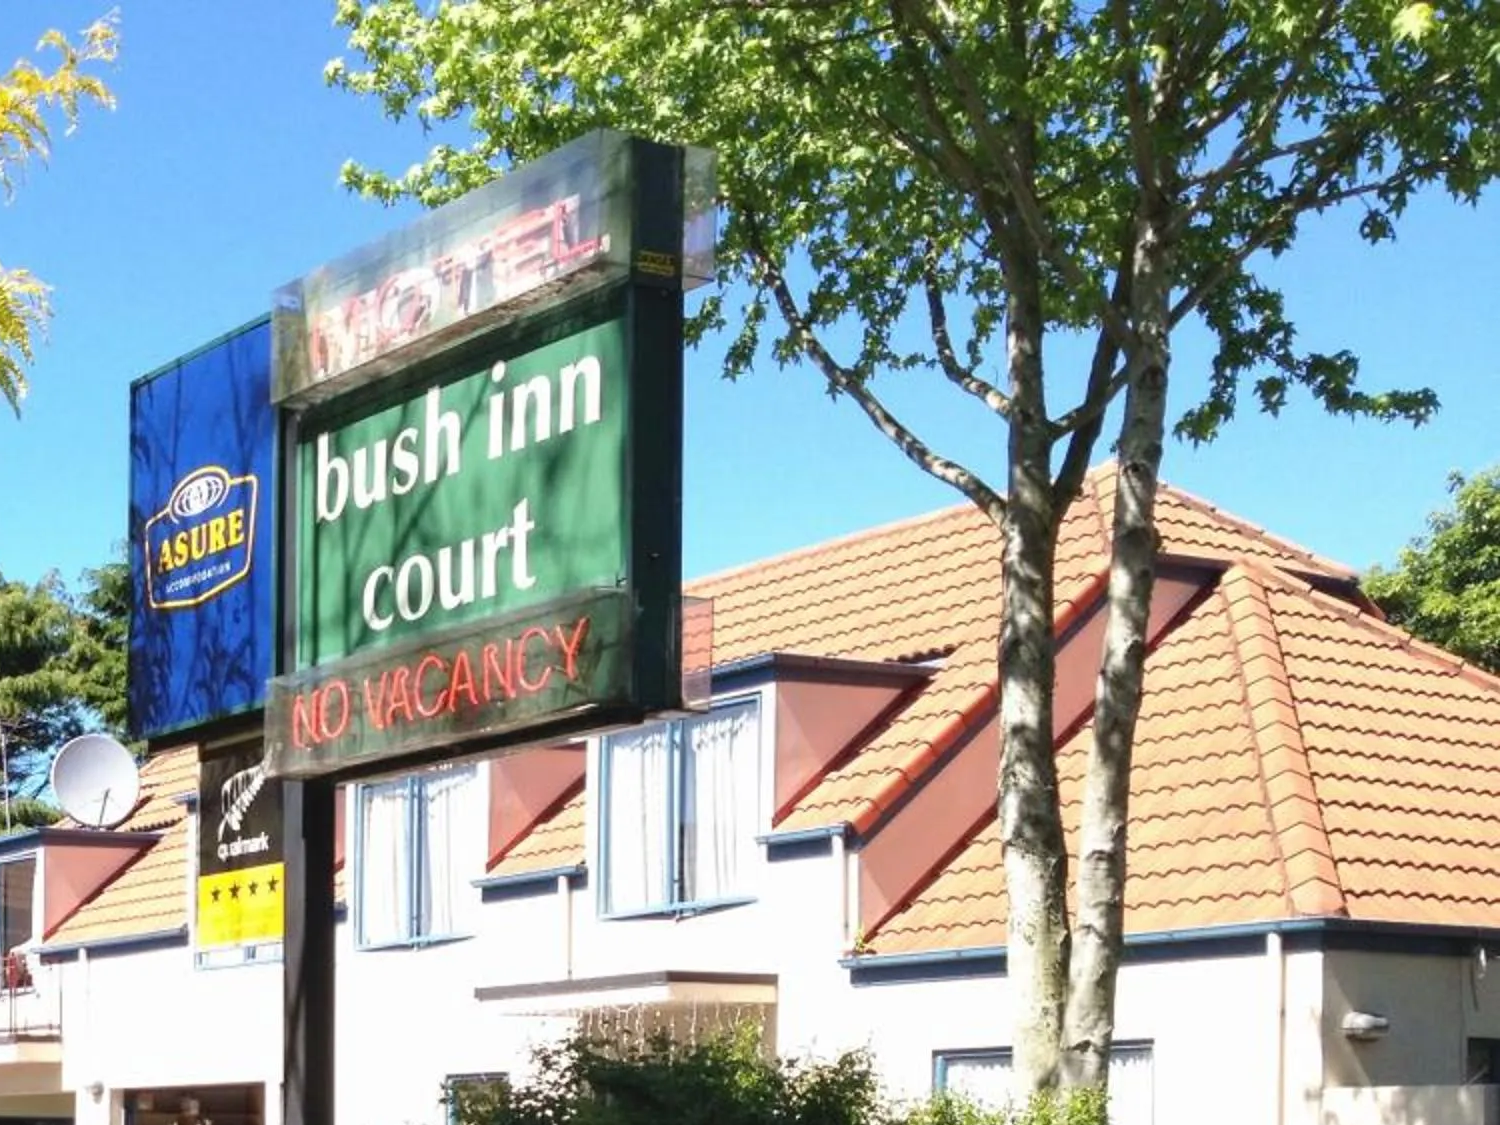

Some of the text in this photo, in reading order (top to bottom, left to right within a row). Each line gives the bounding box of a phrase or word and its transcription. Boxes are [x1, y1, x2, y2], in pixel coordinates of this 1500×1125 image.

[310, 194, 610, 378] MOTEL
[316, 355, 601, 522] bush inn
[158, 509, 244, 573] ASURE
[363, 497, 536, 630] court
[293, 618, 590, 748] NO VACANCY
